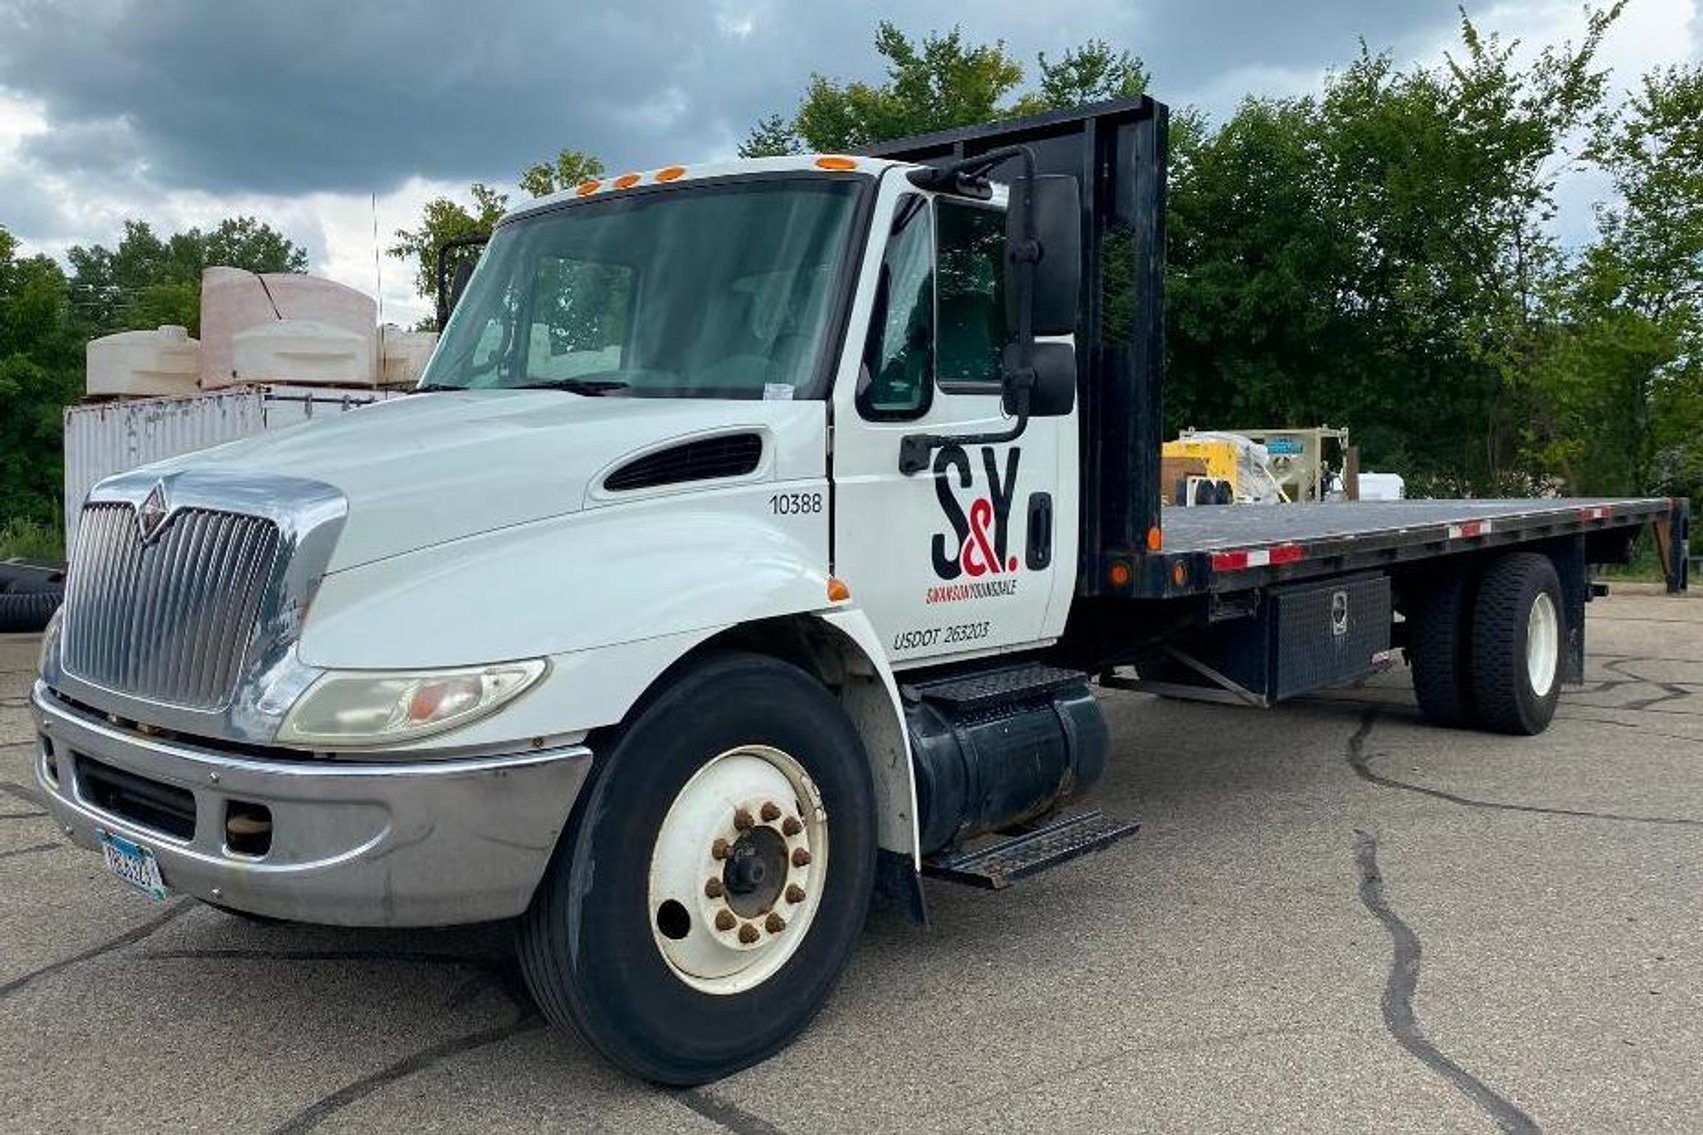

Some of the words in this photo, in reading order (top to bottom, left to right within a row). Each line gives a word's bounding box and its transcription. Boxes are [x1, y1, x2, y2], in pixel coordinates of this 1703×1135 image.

[769, 493, 823, 514] 10388
[893, 628, 941, 650] USDOT
[944, 621, 990, 643] 263203
